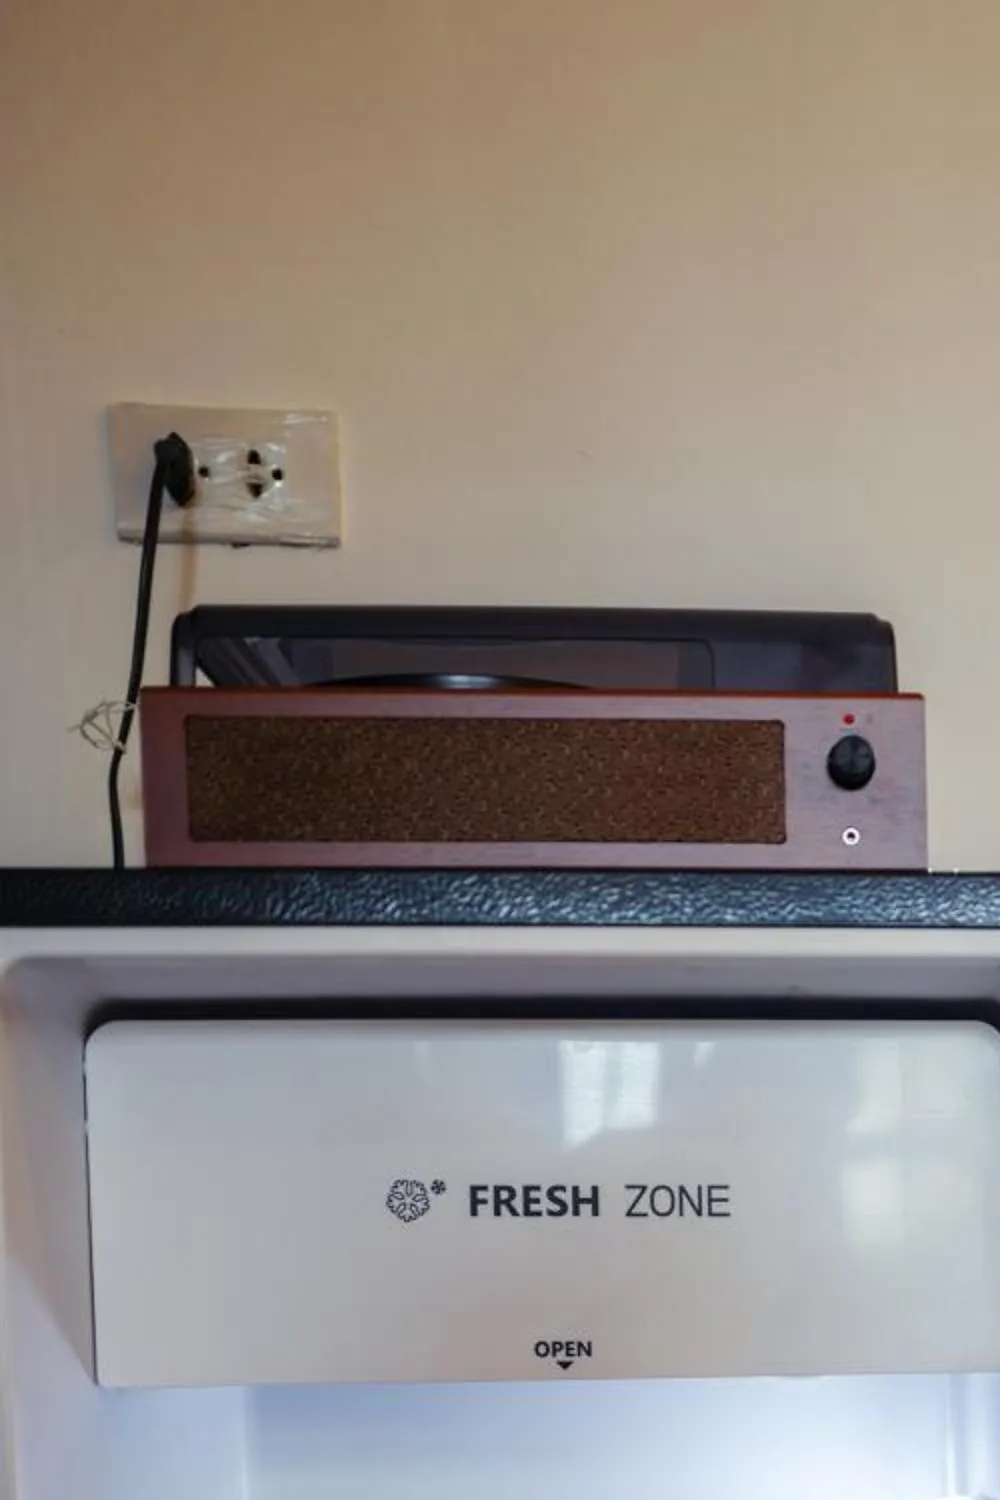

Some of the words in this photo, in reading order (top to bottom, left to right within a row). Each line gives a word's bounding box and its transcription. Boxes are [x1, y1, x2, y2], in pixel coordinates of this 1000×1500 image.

[469, 1184, 600, 1218] FRESH
[624, 1184, 732, 1218] ZONE
[534, 1340, 593, 1358] OPEN
